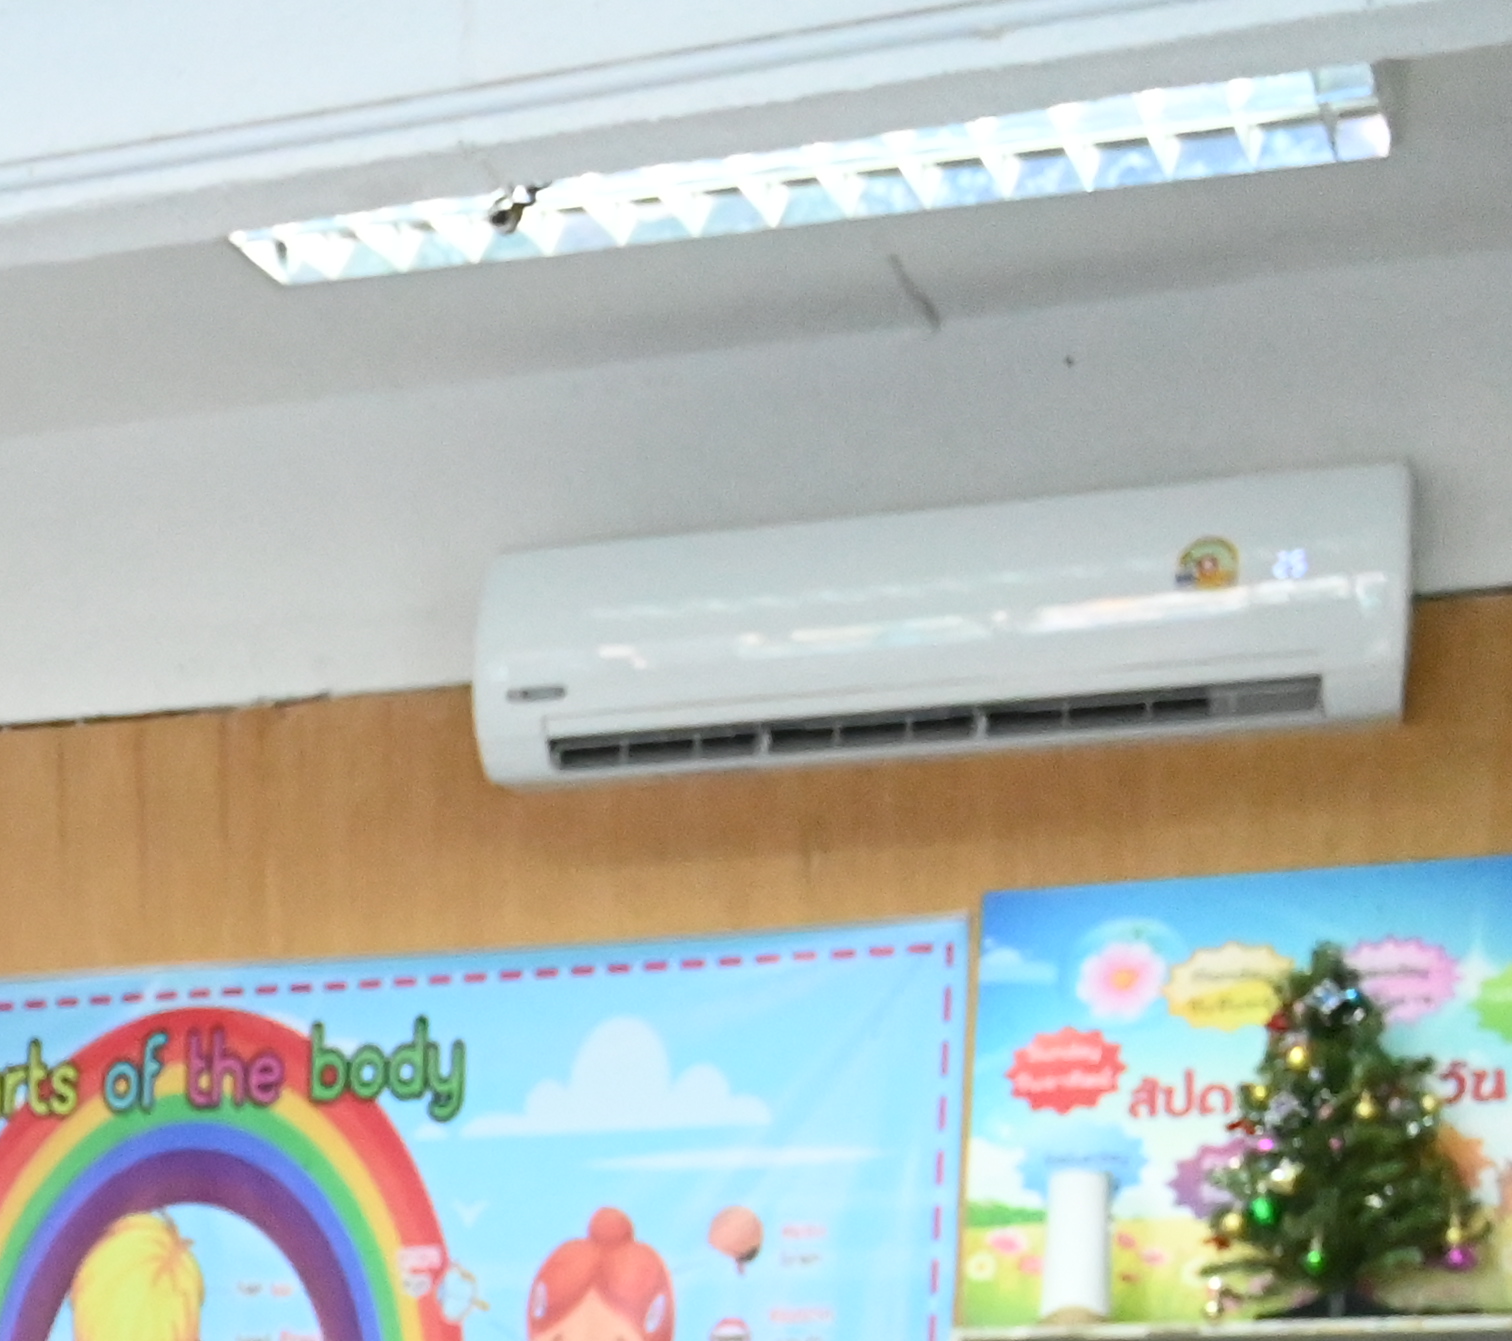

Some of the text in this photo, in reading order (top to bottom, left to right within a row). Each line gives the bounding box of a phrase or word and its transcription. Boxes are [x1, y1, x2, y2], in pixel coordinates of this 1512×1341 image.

[103, 1030, 168, 1113] of
[185, 1025, 285, 1110] the
[309, 1015, 464, 1123] body
